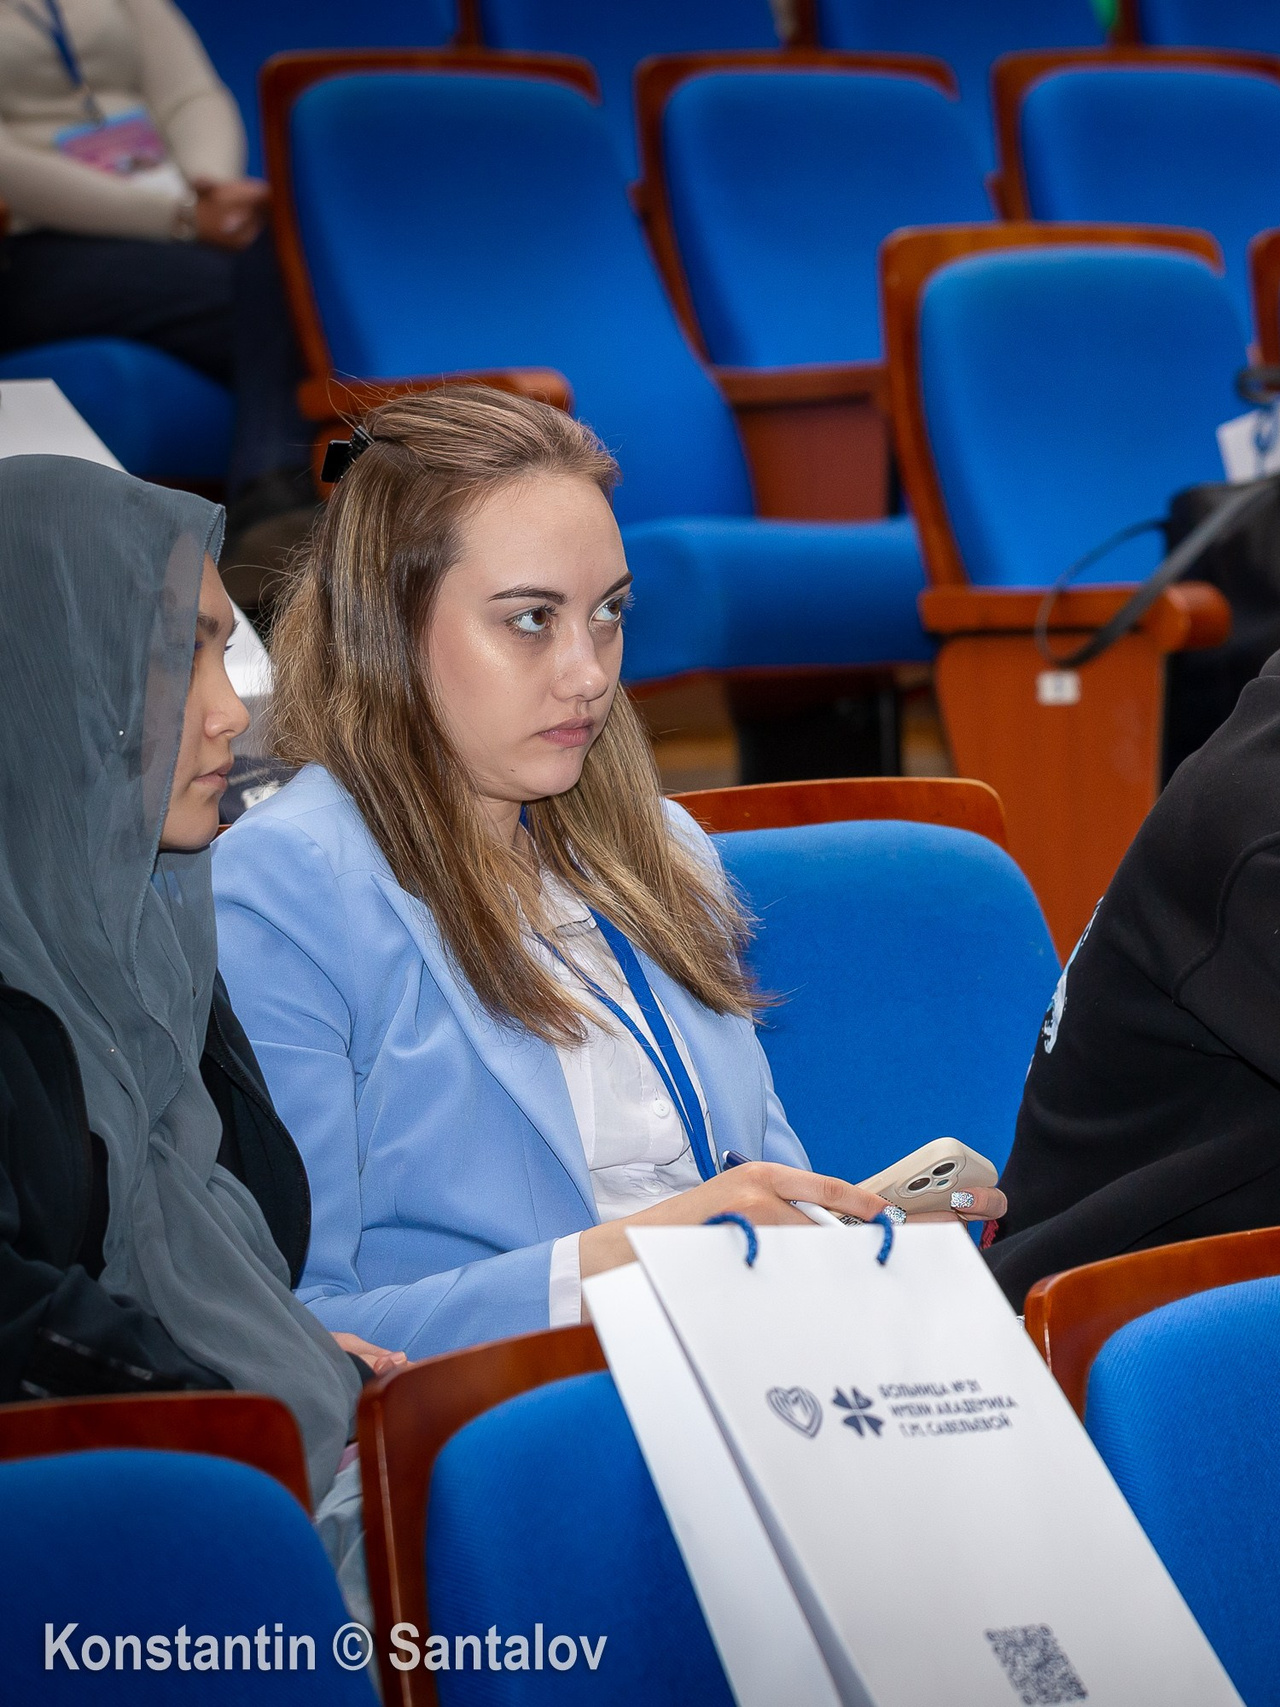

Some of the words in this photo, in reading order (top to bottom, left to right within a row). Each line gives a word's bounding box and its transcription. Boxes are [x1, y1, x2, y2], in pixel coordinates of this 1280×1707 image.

[878, 1382, 949, 1399] БОЛЬНИЦА
[890, 1402, 934, 1417] ИМЕНИ
[936, 1395, 1018, 1415] АКАДЕМИКА
[927, 1412, 1012, 1436] САВЕЛЬЕВОЙ
